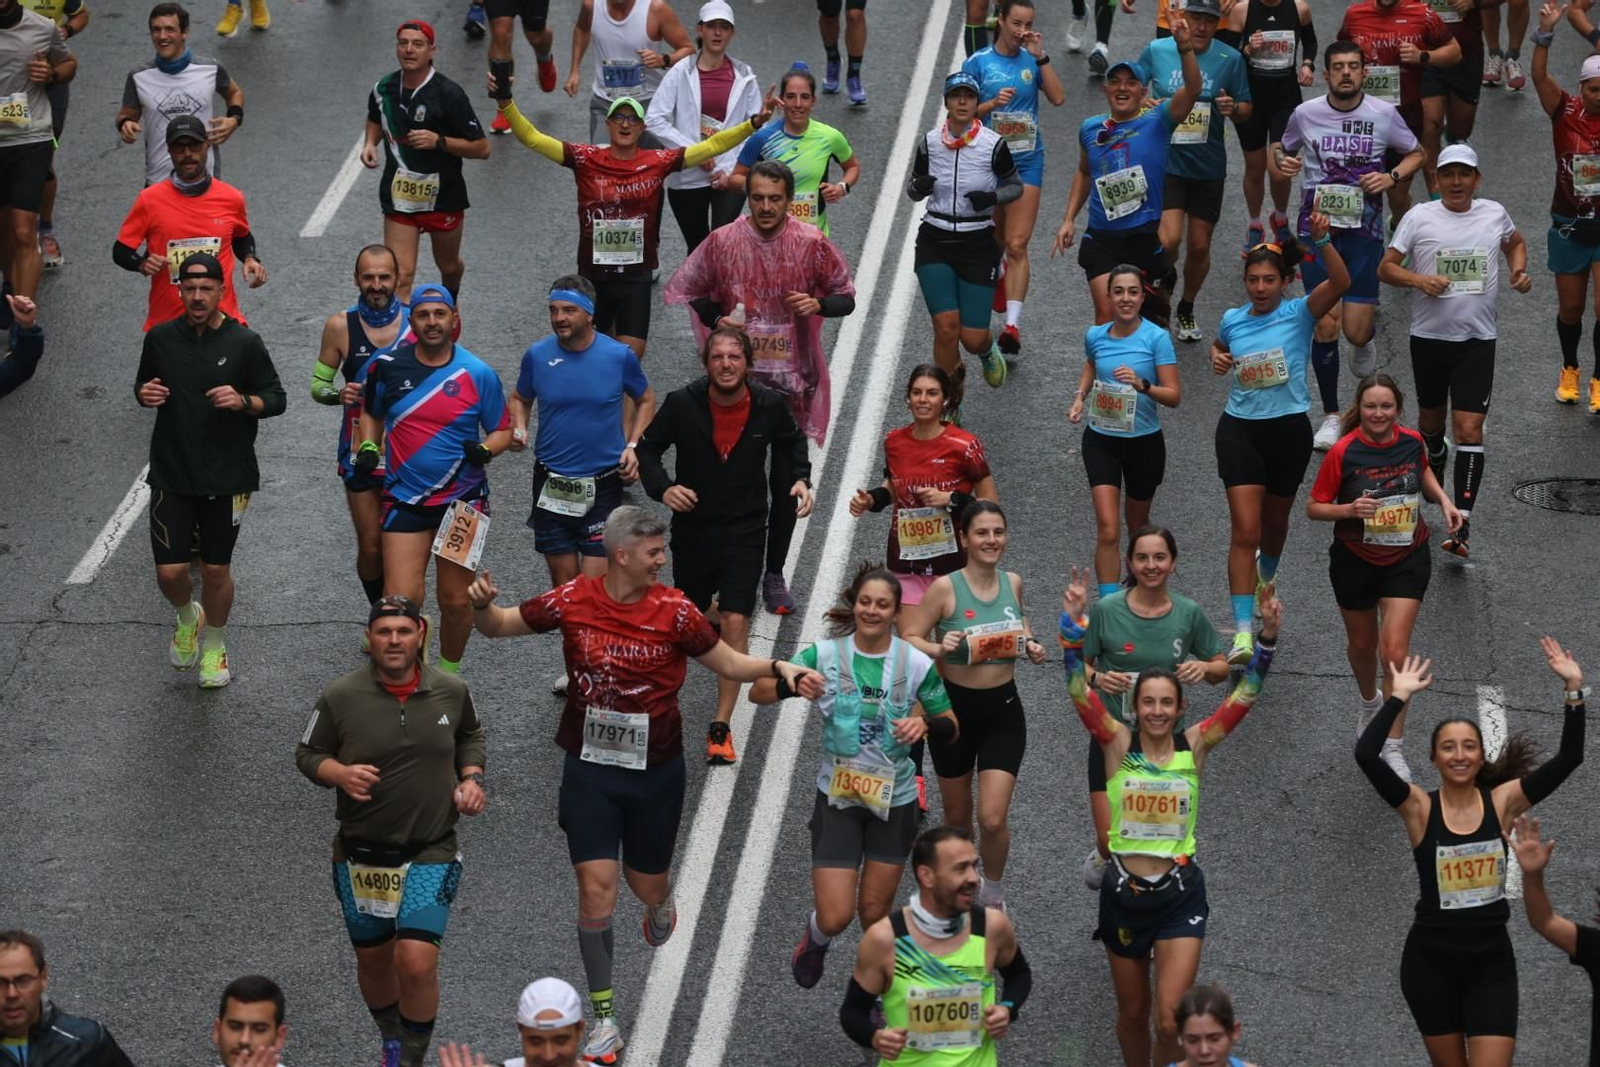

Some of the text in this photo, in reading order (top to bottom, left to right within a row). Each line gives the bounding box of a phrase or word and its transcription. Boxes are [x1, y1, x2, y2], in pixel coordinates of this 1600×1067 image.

[609, 68, 636, 81] 2177
[1181, 112, 1203, 125] 64
[1342, 120, 1374, 135] THE
[1322, 135, 1374, 155] LAST
[396, 180, 432, 196] 13815
[1106, 180, 1136, 200] 8939
[1321, 195, 1351, 209] 8231
[598, 231, 637, 245] 10374
[1444, 259, 1477, 275] 7074
[446, 516, 472, 552] 3912
[901, 518, 942, 538] 13987
[1172, 638, 1184, 658] S
[588, 721, 636, 744] 17971
[835, 771, 883, 796] 13607
[1126, 793, 1178, 814] 10761
[1443, 857, 1496, 881] 11377
[355, 872, 401, 892] 14809
[913, 1001, 970, 1025] 10760
